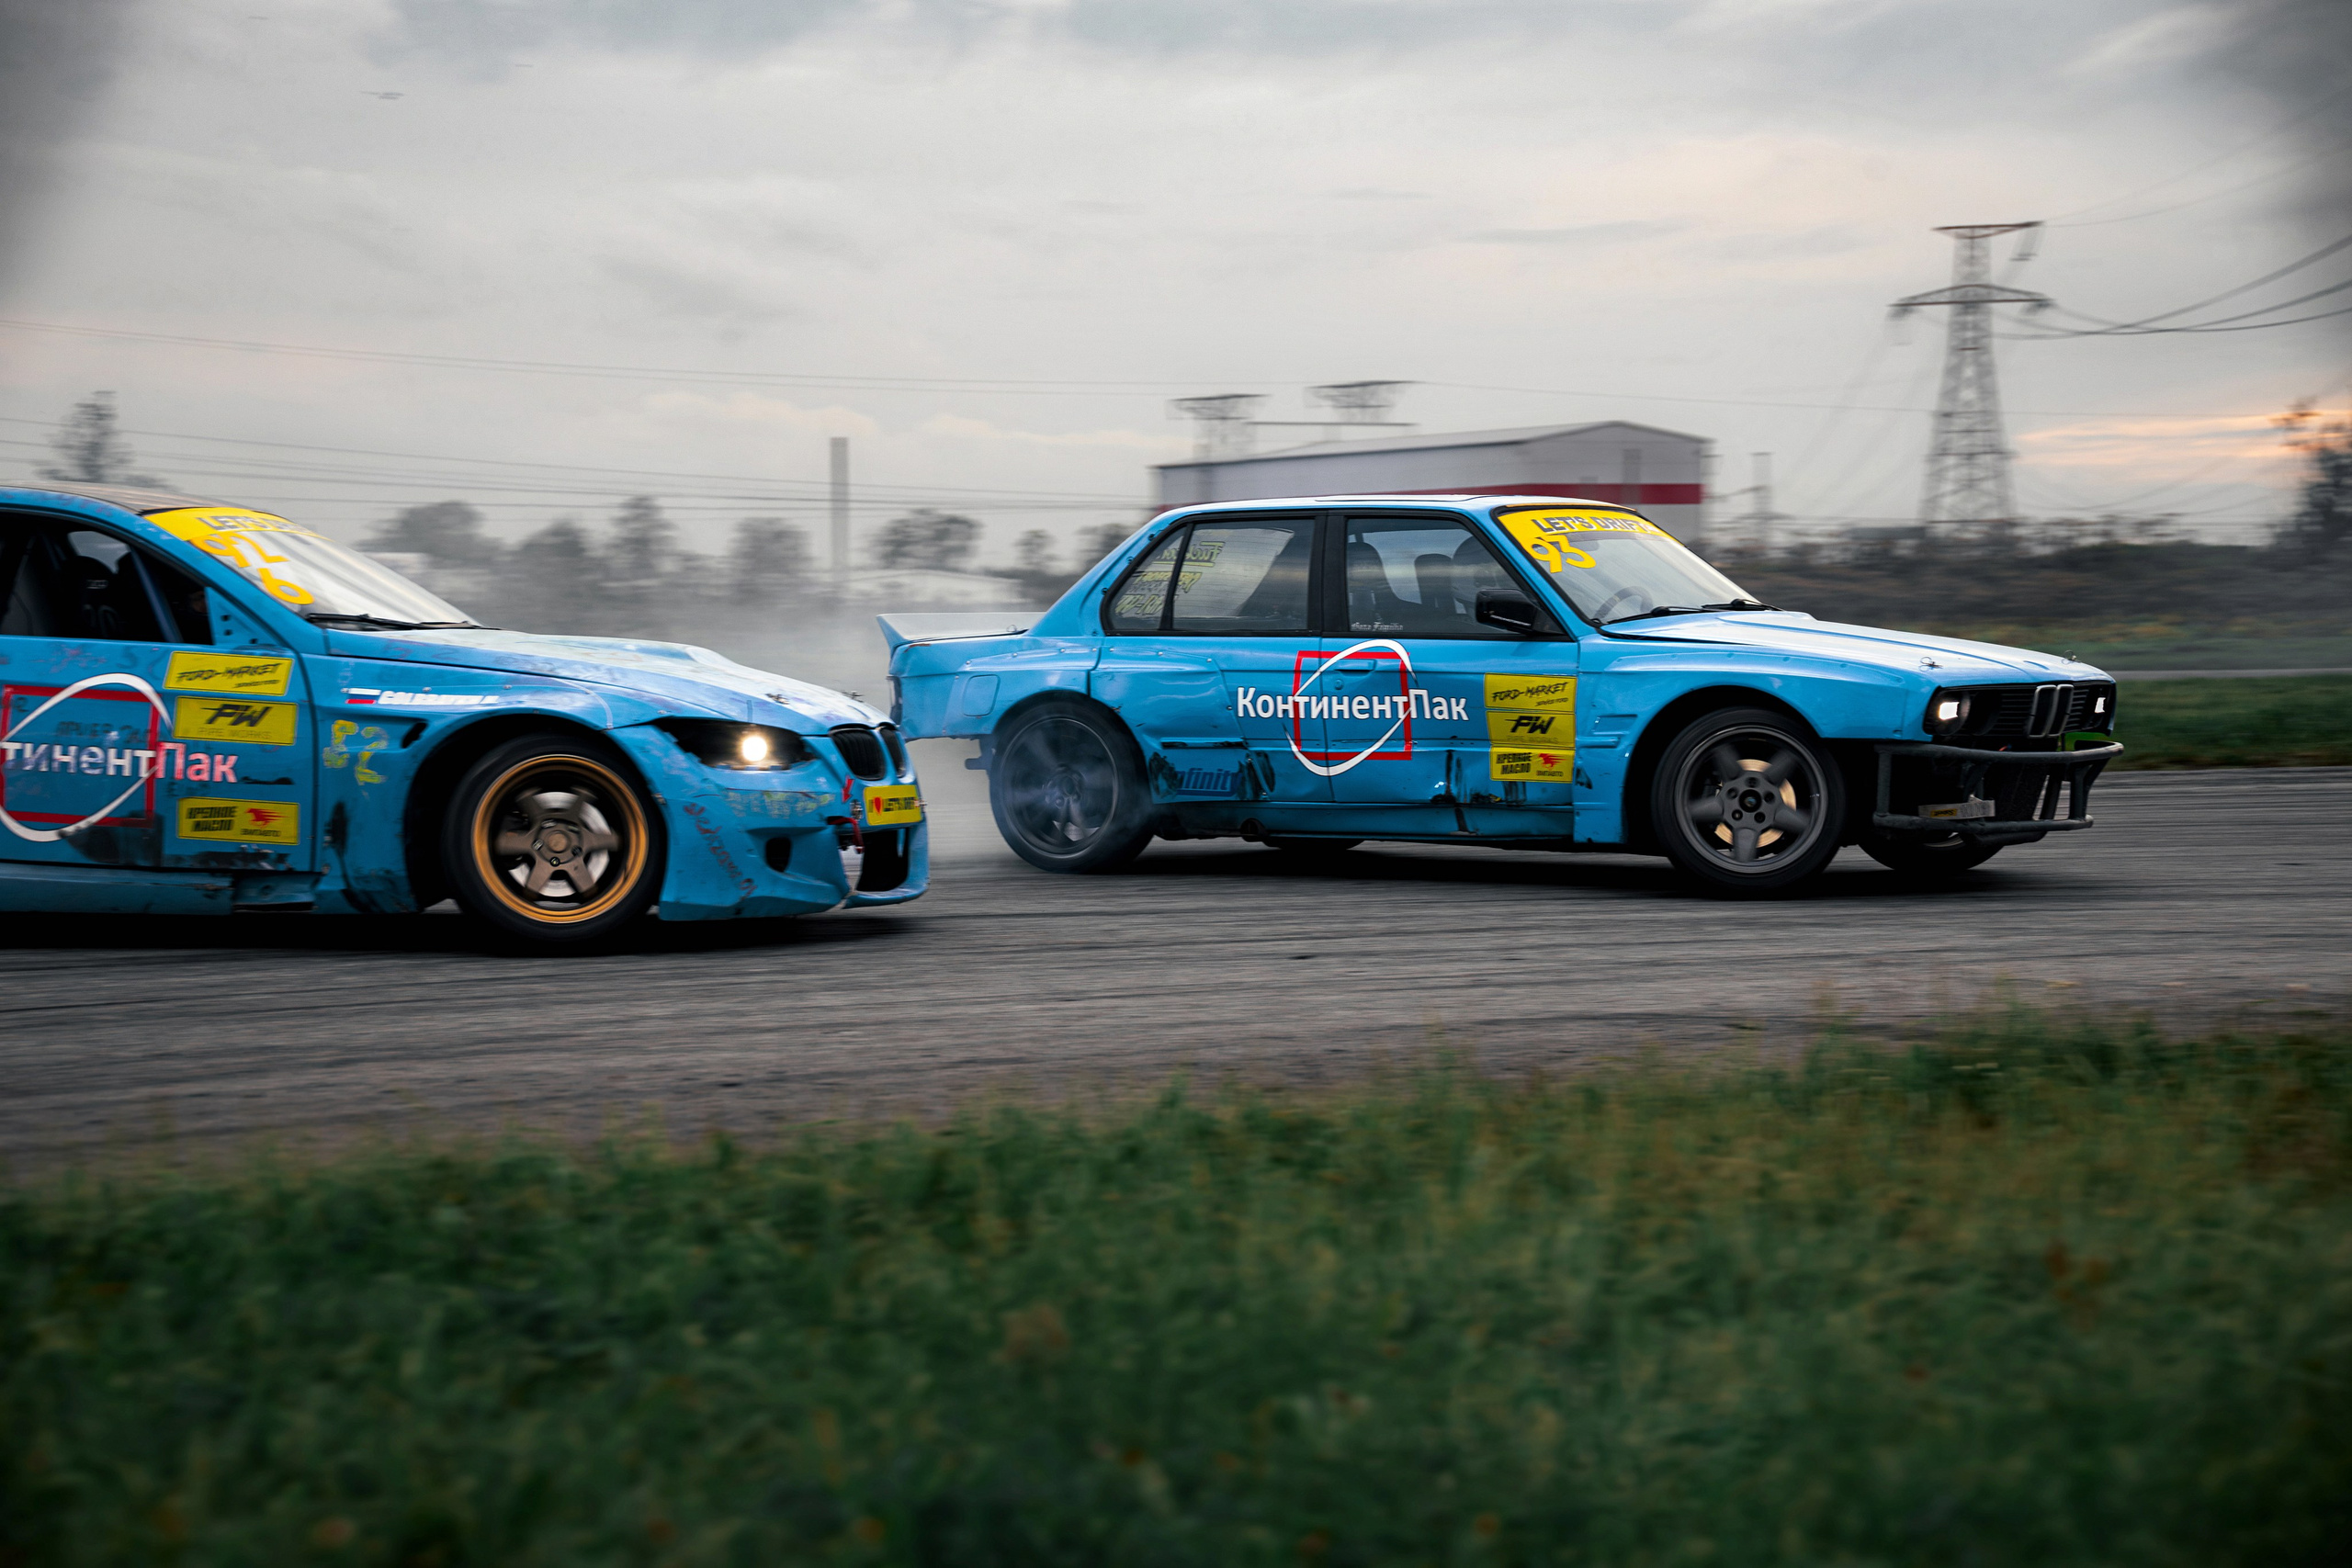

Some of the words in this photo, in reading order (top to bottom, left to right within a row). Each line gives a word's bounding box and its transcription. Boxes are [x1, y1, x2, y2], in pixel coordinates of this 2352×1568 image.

[1531, 515, 1597, 534] LET'S
[1590, 516, 1651, 534] DRIFT
[1521, 535, 1597, 573] 93
[1237, 686, 1470, 721] КонтинентПак
